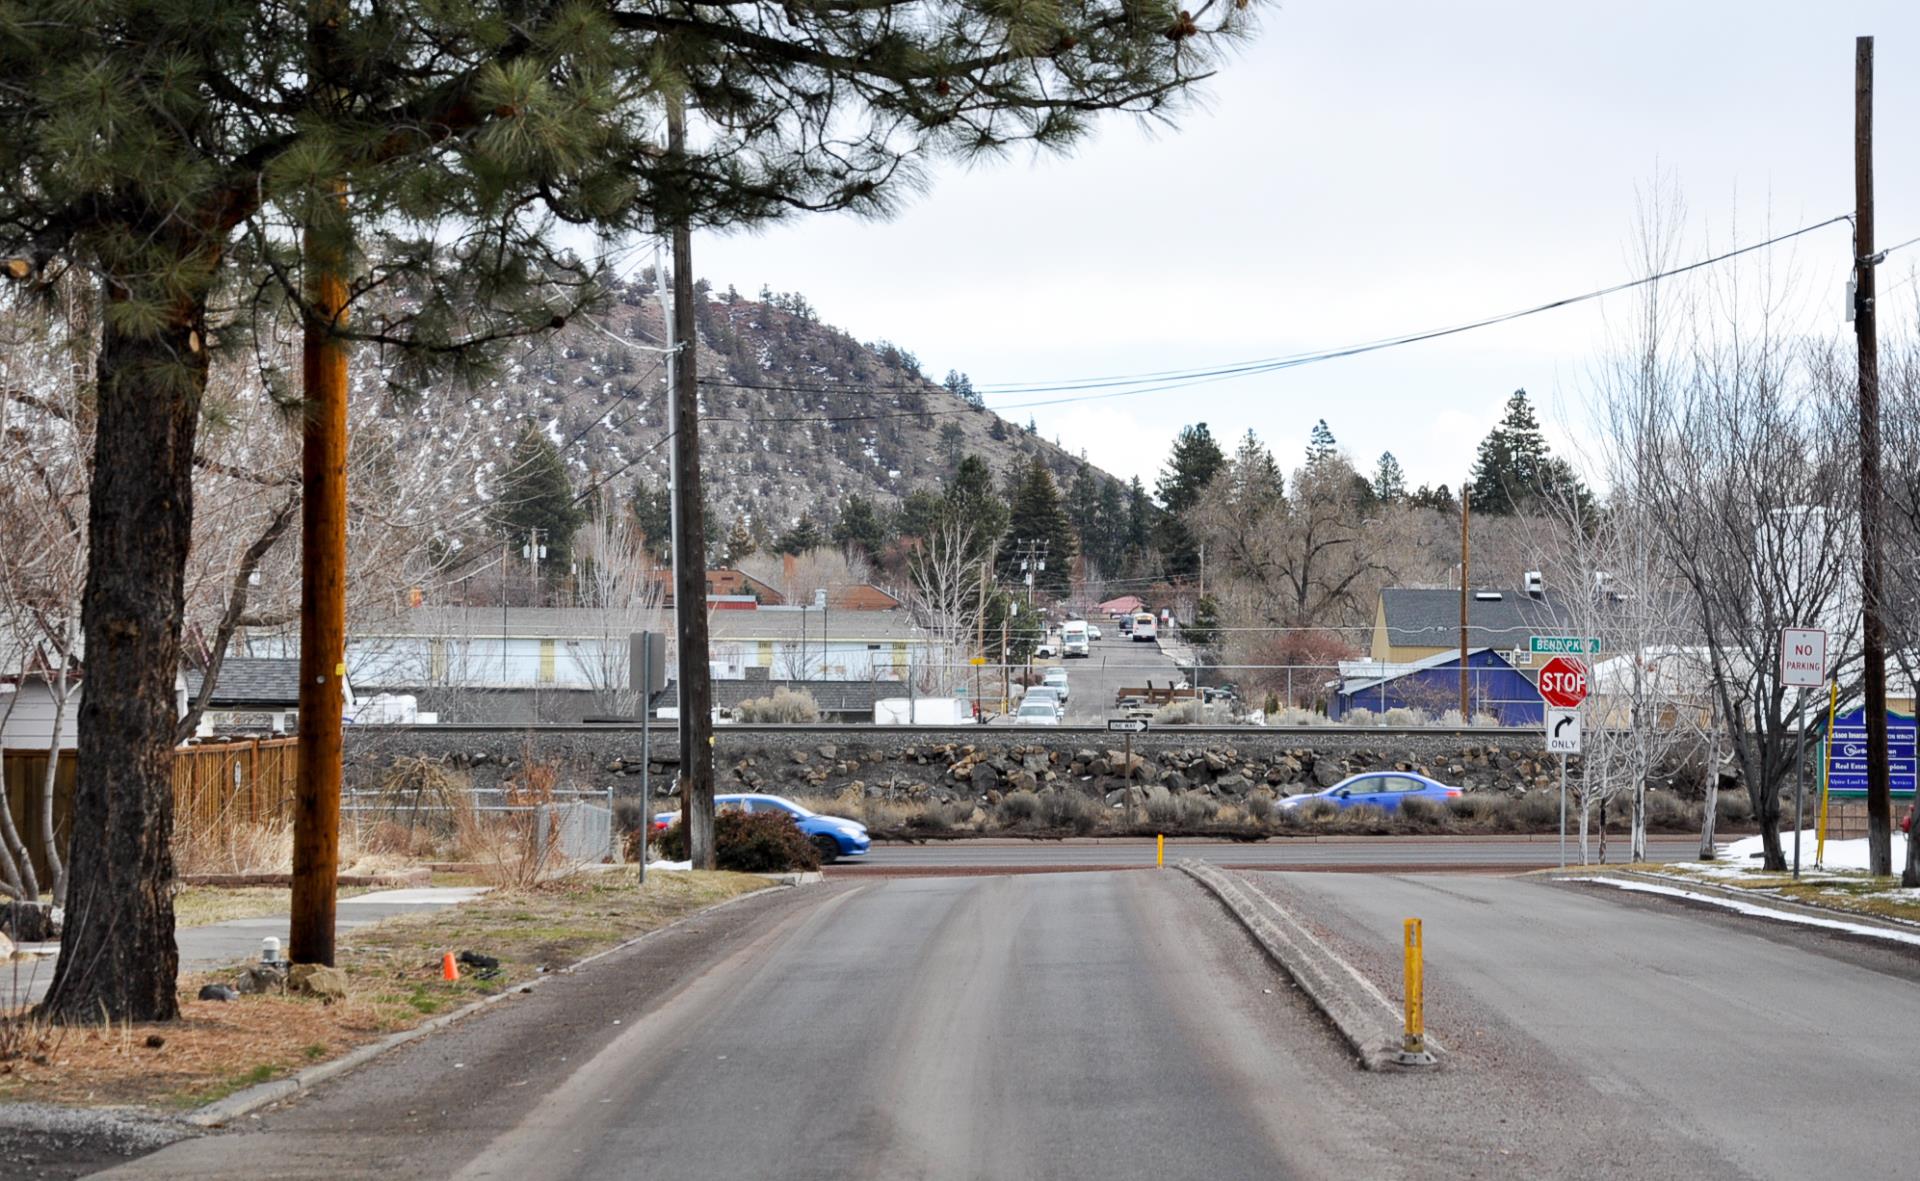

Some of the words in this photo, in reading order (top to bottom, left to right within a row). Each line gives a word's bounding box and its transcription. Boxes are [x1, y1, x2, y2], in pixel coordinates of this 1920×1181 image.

[1537, 640, 1562, 651] BEND
[1566, 640, 1594, 652] PKY
[1795, 644, 1812, 656] NO
[1786, 661, 1820, 671] PARKING
[1542, 671, 1586, 693] STOP
[1551, 739, 1577, 749] ONLY
[1850, 762, 1868, 770] Estat
